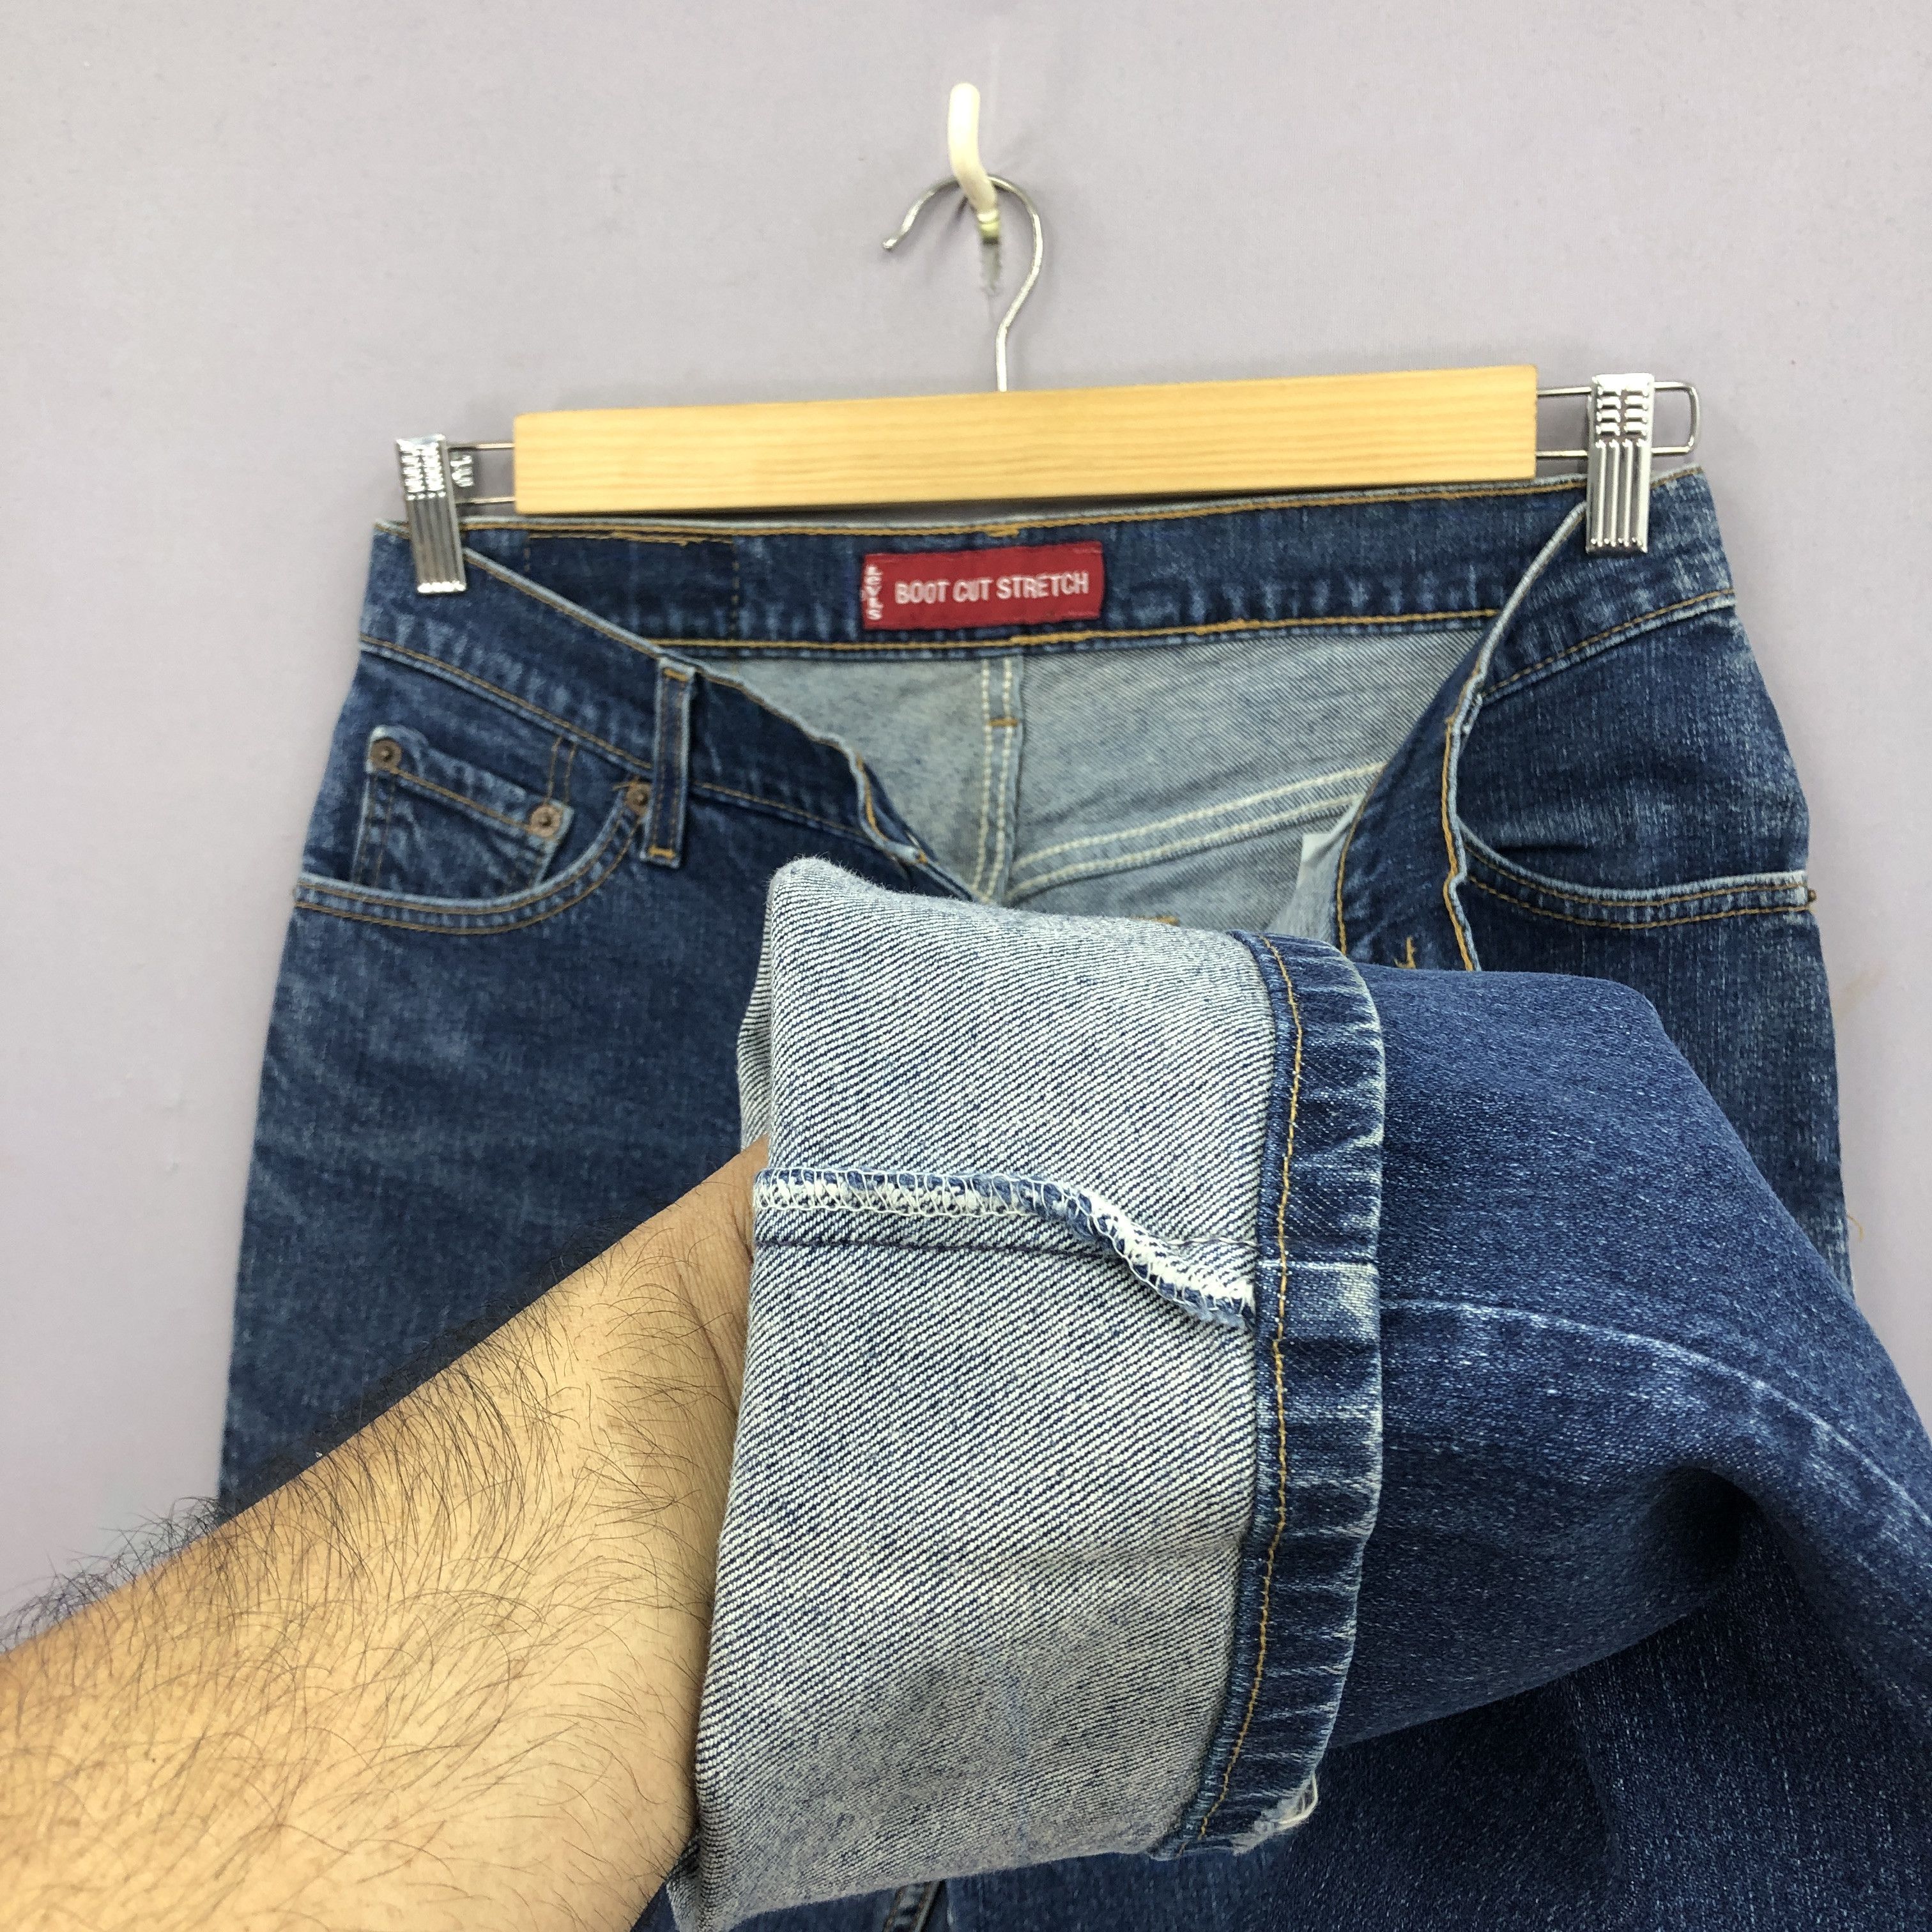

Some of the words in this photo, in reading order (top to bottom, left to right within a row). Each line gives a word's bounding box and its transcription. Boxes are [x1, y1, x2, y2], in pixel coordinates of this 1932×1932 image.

[895, 581, 950, 604] BOOT
[953, 578, 993, 602] CUT
[996, 572, 1089, 599] STRETCH
